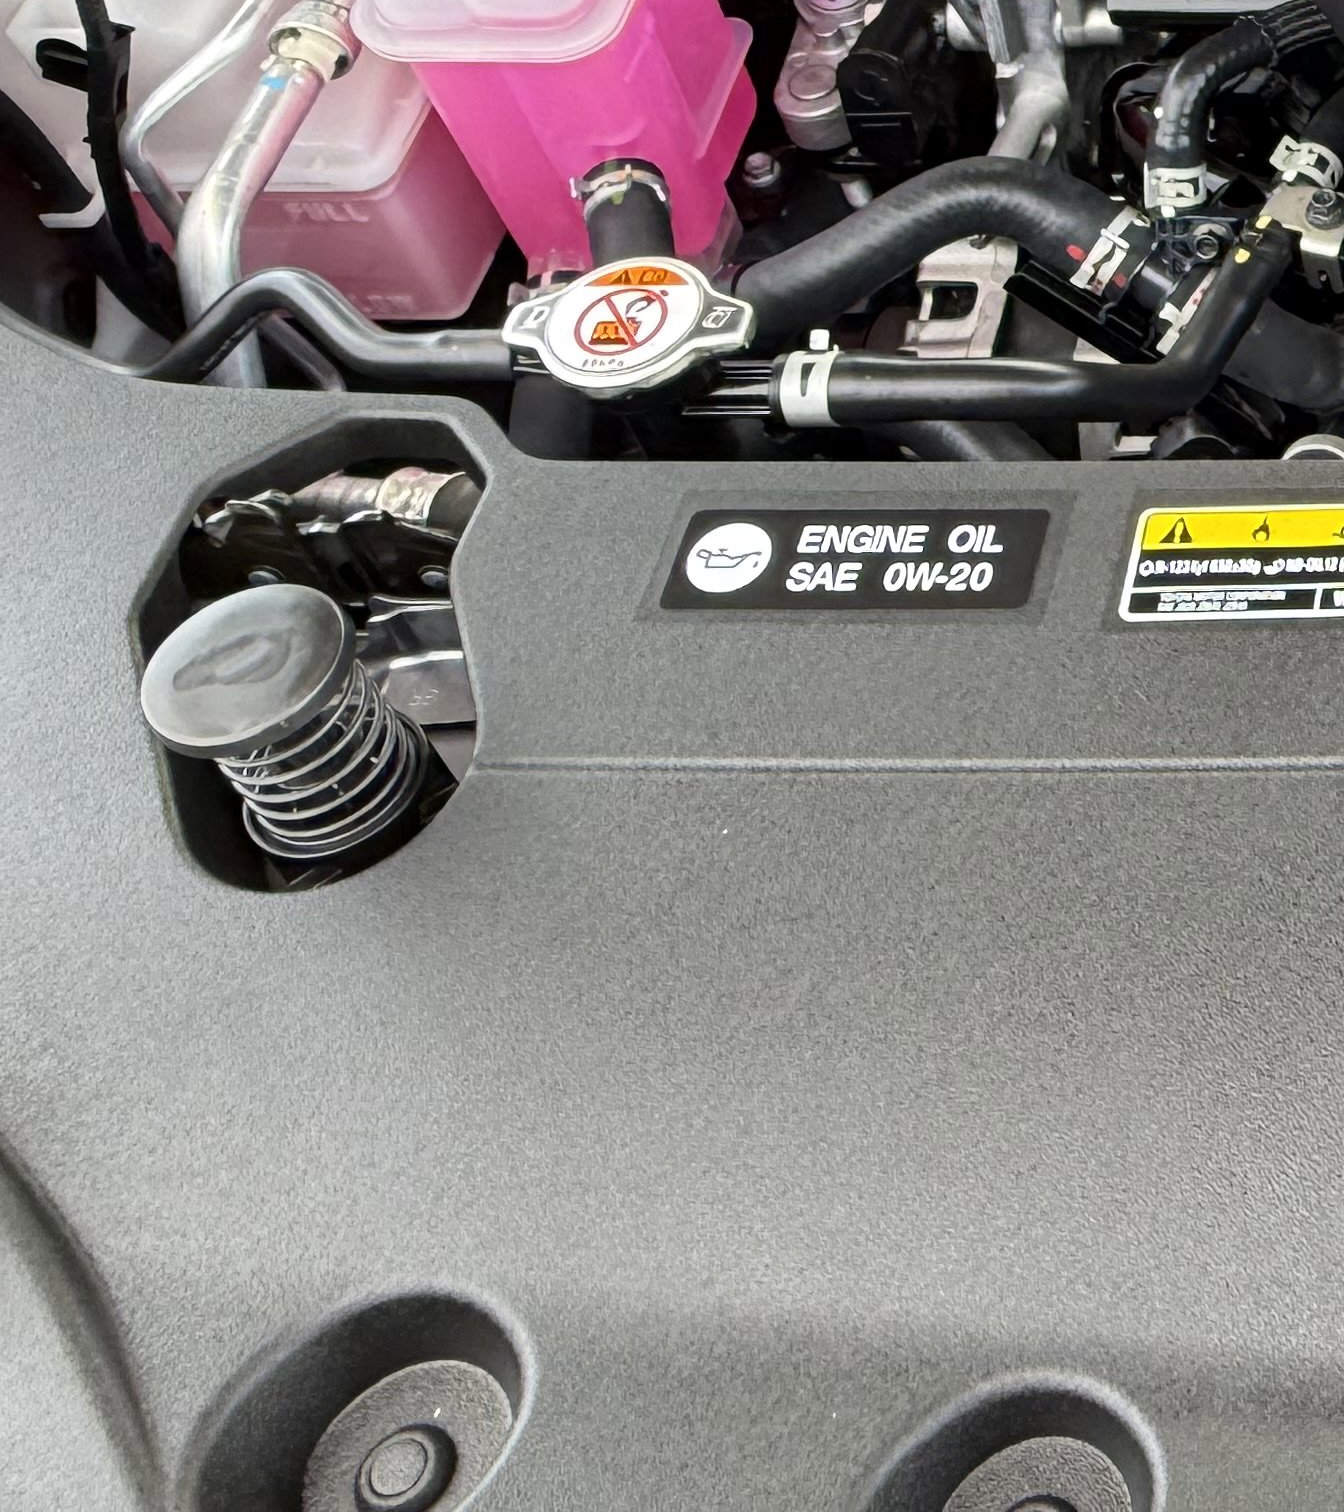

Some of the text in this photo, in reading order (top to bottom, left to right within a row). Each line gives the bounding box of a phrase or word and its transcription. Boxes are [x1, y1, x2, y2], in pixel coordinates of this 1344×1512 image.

[796, 524, 1004, 554] ENGINE OIL
[785, 561, 994, 593] SAE 0W-20
